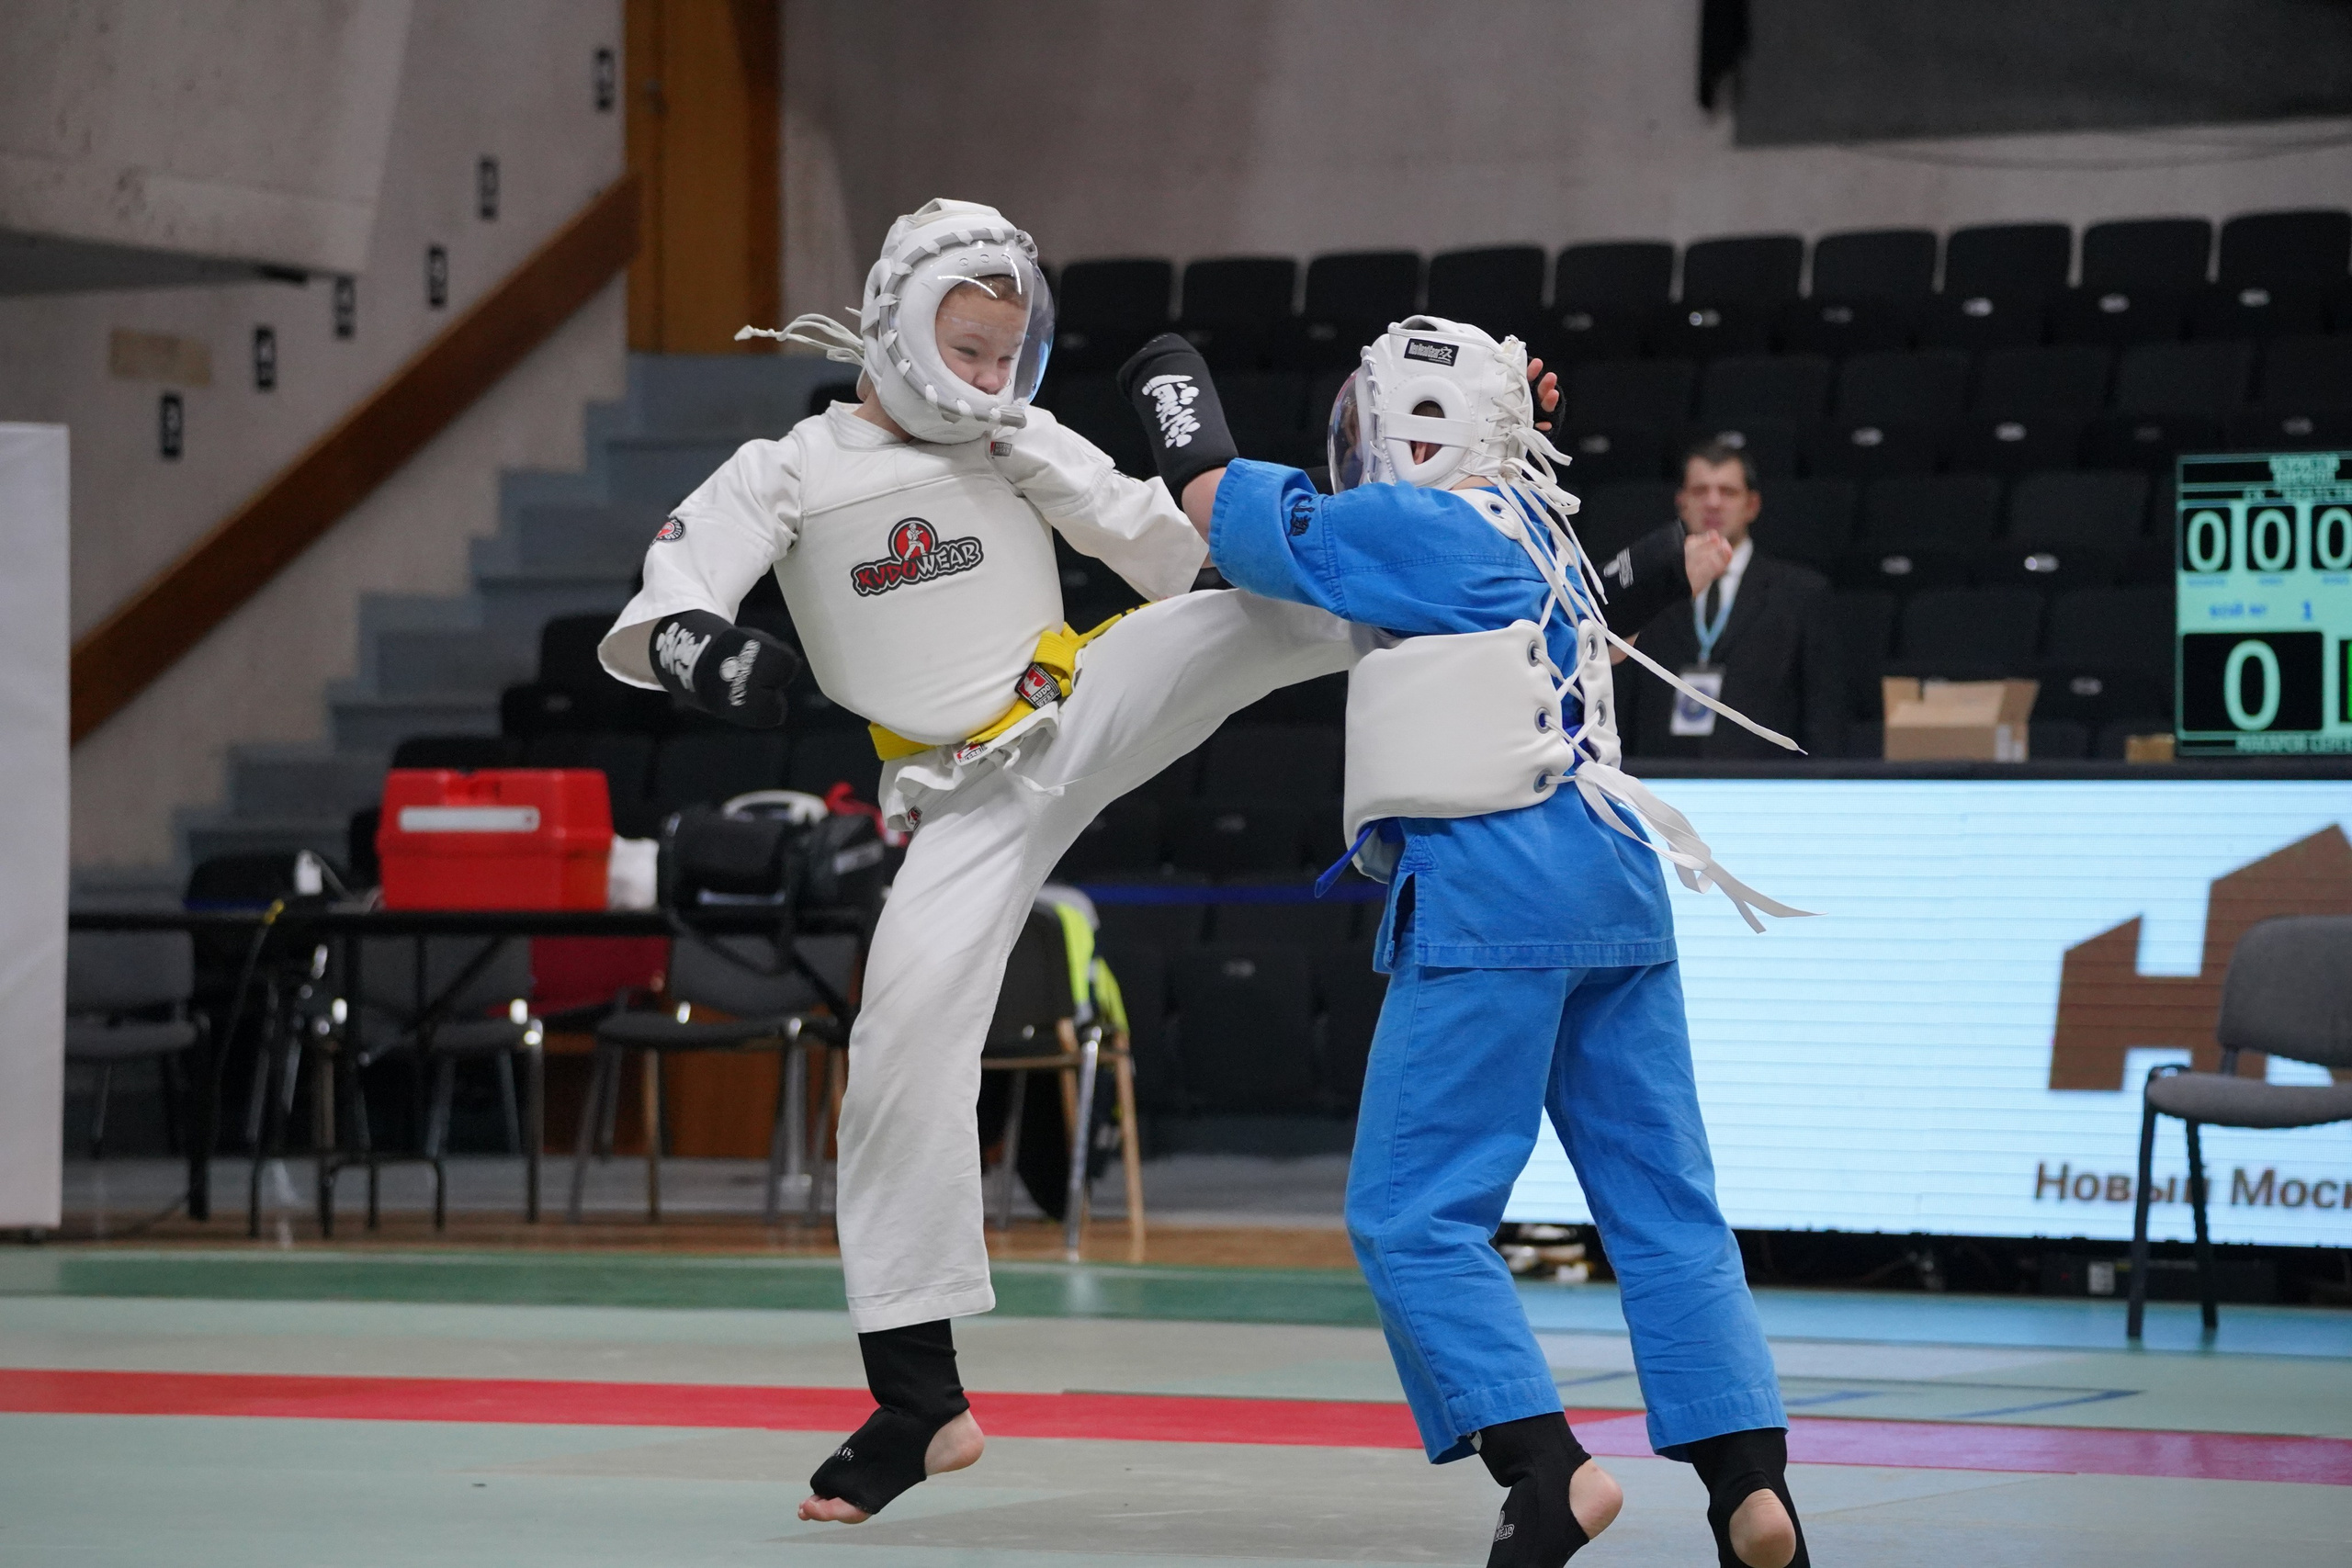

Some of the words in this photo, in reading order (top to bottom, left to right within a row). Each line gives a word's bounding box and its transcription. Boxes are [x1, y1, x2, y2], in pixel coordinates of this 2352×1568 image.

[2187, 509, 2227, 572] 0
[2251, 508, 2291, 572] 0
[2316, 507, 2352, 572] 0
[1030, 684, 1051, 702] KUDO
[1036, 692, 1056, 707] WEAR
[2223, 639, 2281, 732] 0
